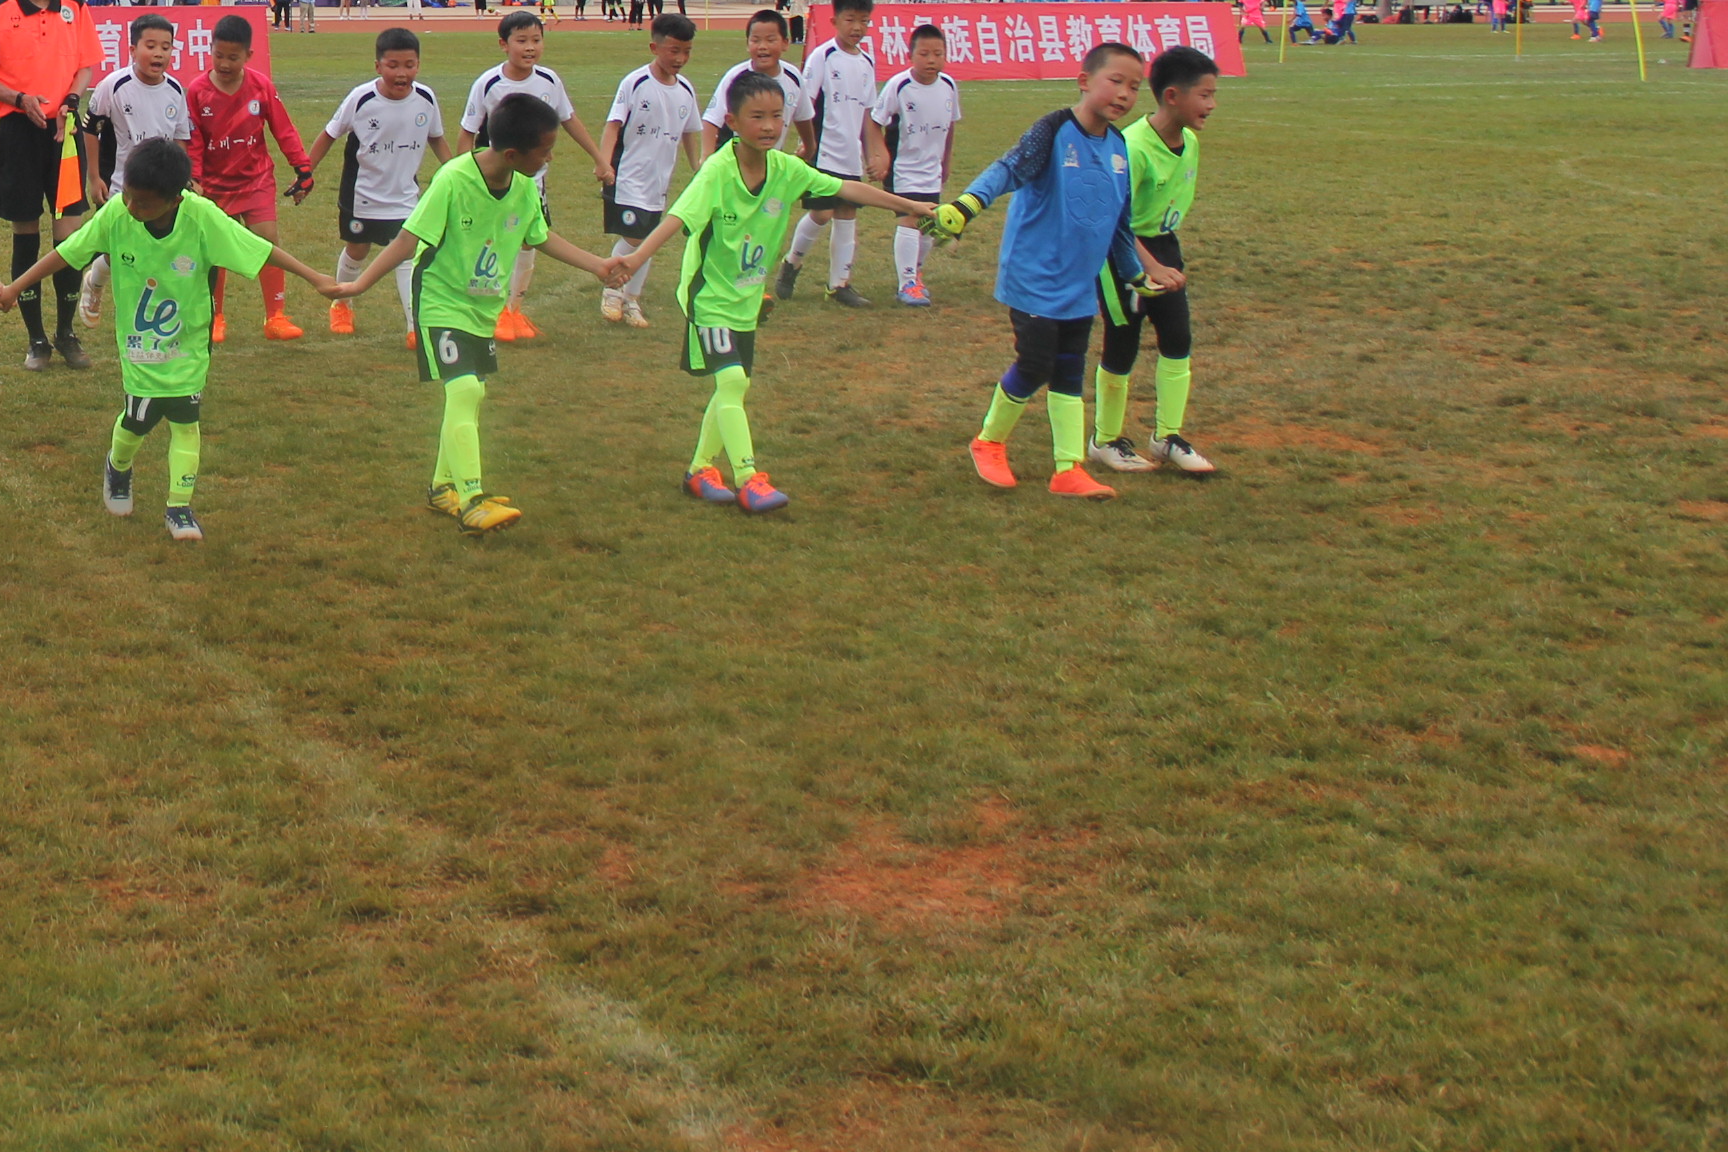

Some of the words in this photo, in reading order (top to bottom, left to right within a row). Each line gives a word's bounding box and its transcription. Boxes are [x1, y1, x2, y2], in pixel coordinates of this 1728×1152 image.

[369, 141, 420, 154] 东川一小
[438, 330, 459, 364] 6
[698, 327, 733, 355] 10
